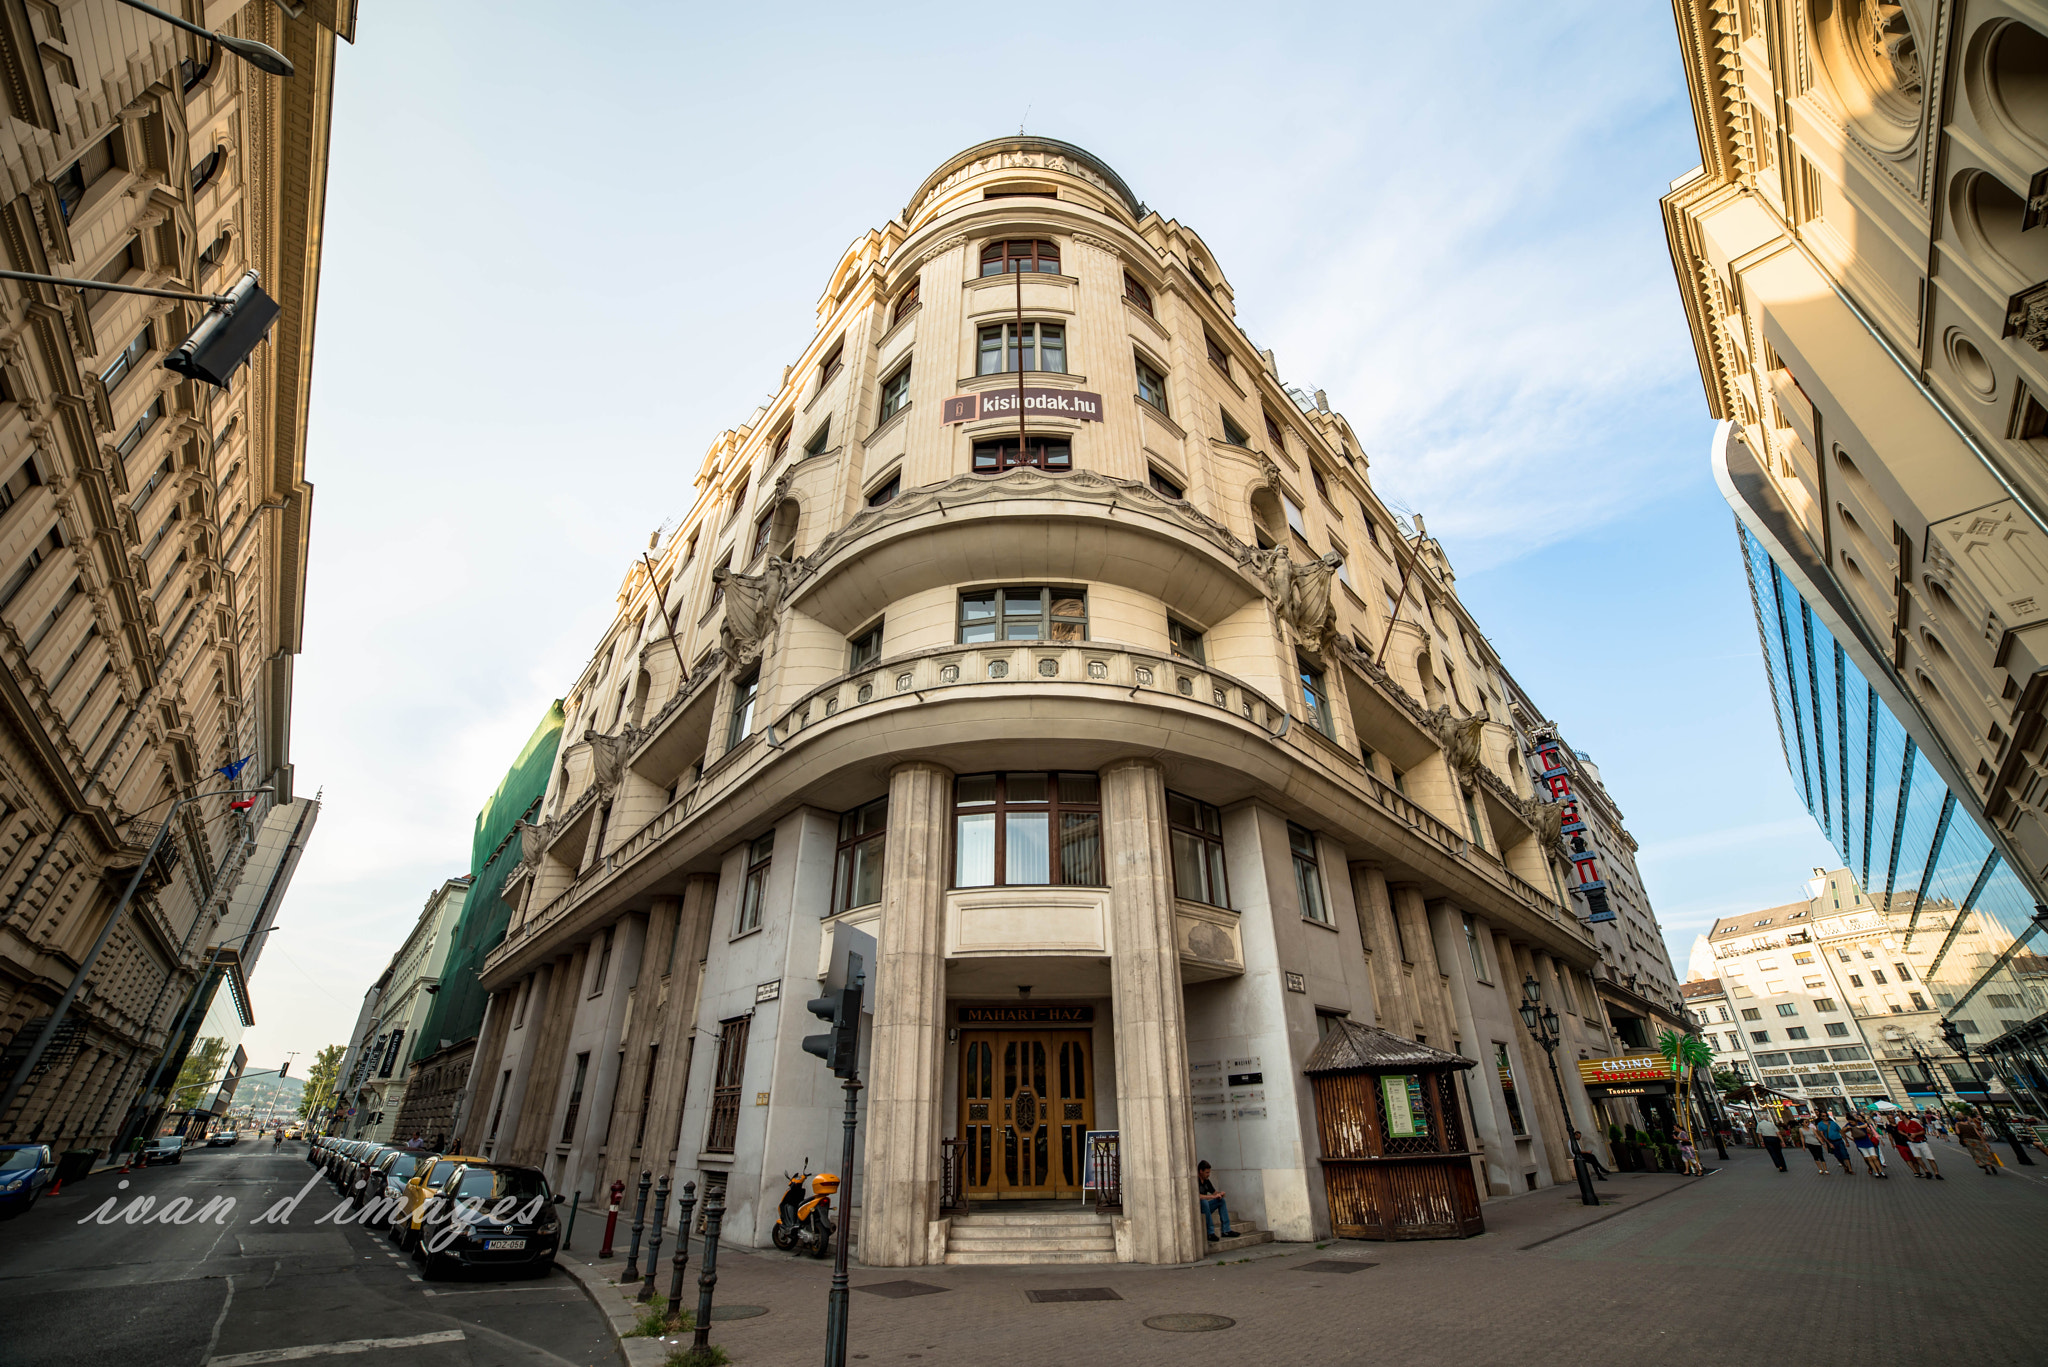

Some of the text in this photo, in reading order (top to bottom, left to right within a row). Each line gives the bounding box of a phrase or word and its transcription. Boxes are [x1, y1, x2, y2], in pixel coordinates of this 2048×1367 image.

[1602, 1057, 1653, 1072] CASINO
[1760, 1067, 1790, 1076] Thomas
[1790, 1065, 1812, 1074] Cook
[1817, 1062, 1875, 1073] Neckermann
